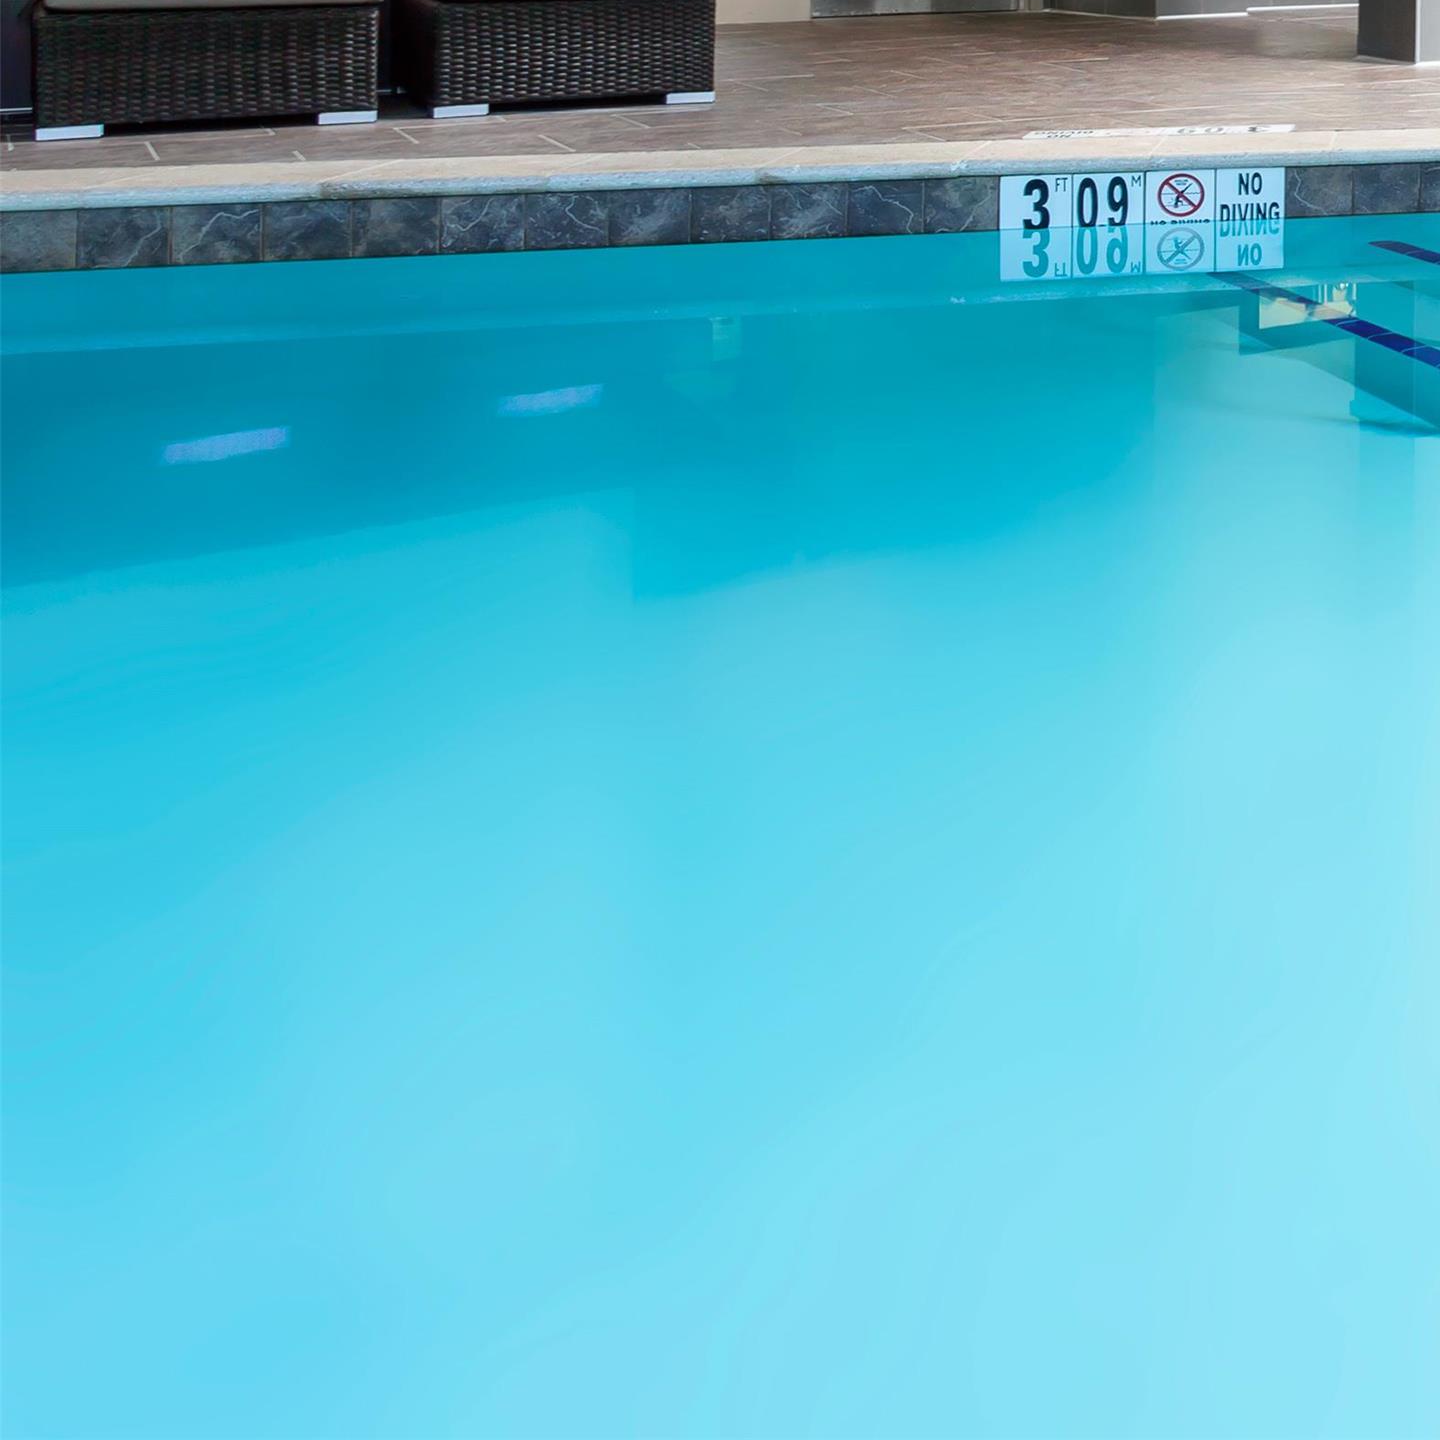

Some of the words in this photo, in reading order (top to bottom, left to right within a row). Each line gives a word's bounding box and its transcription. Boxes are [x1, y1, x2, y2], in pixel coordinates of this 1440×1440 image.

[1238, 172, 1262, 195] NO
[1022, 178, 1050, 229] 3
[1055, 177, 1068, 193] FT
[1131, 175, 1141, 187] M
[1220, 202, 1280, 221] DIVING
